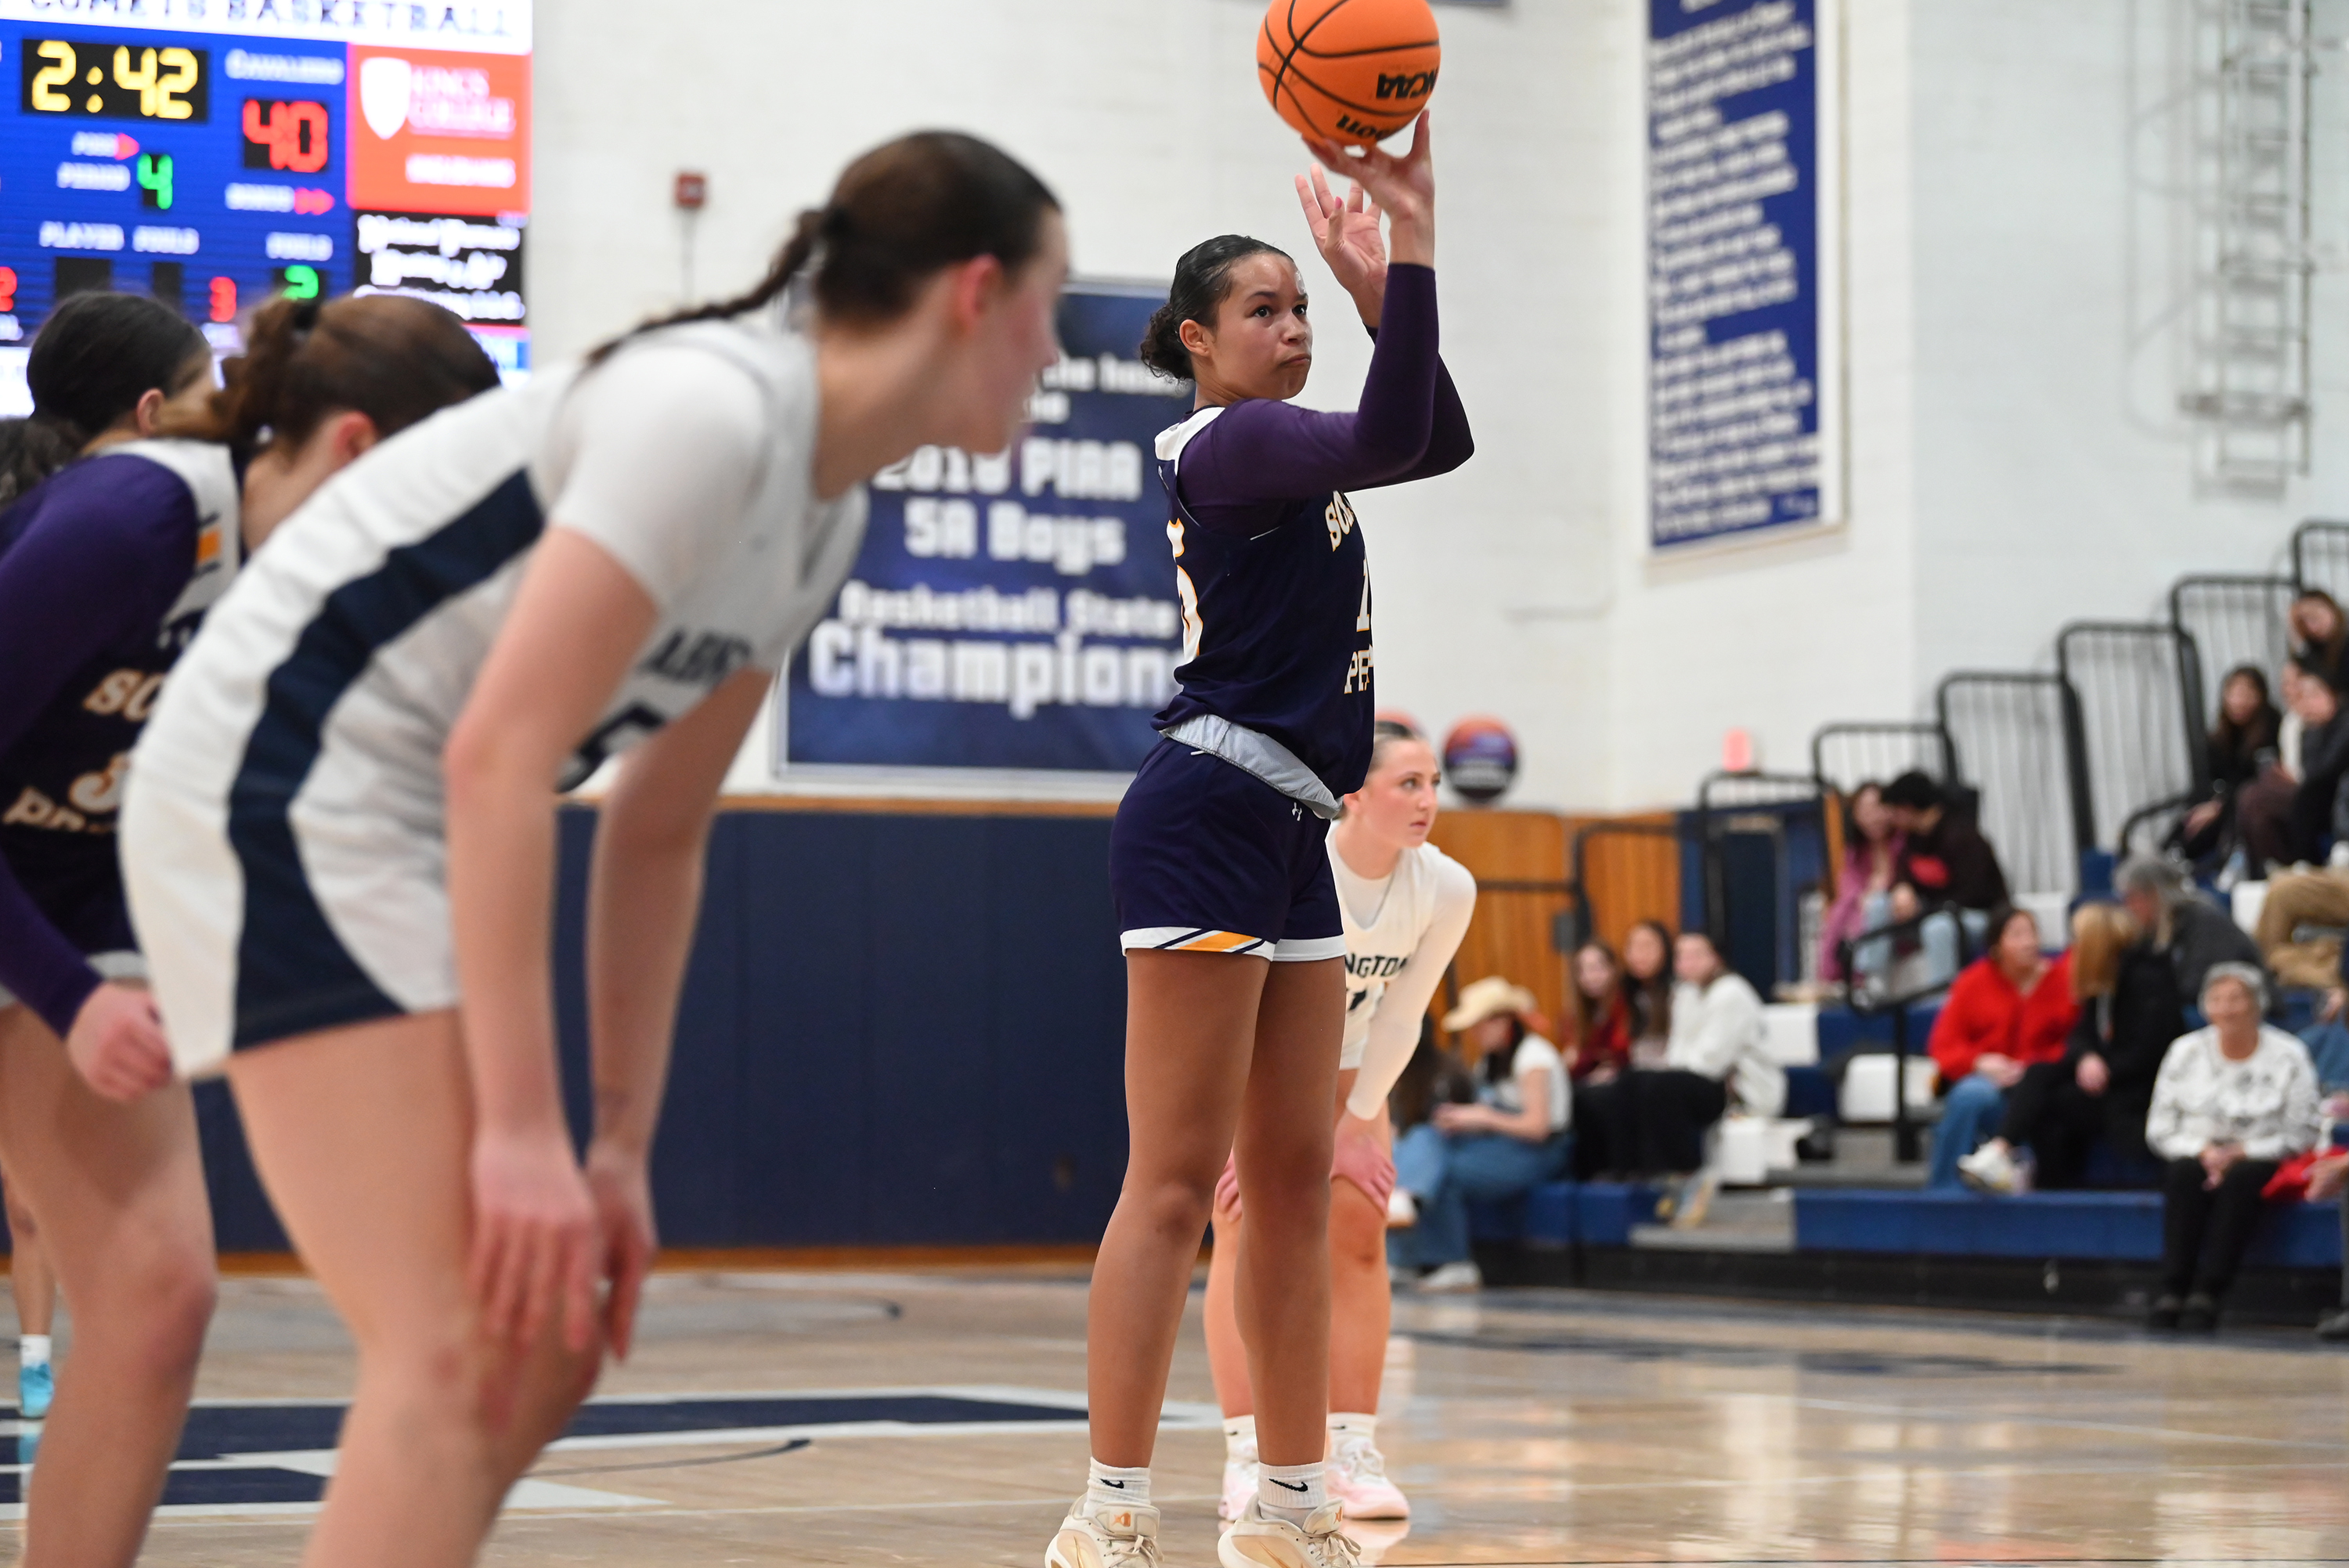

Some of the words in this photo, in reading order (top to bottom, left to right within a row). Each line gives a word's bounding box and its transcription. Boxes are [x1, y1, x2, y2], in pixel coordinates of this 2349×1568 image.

[32, 40, 198, 119] 2:42
[243, 99, 328, 173] 40
[137, 153, 173, 210] 4
[987, 499, 1128, 576] Boys
[809, 618, 1184, 721] Champion
